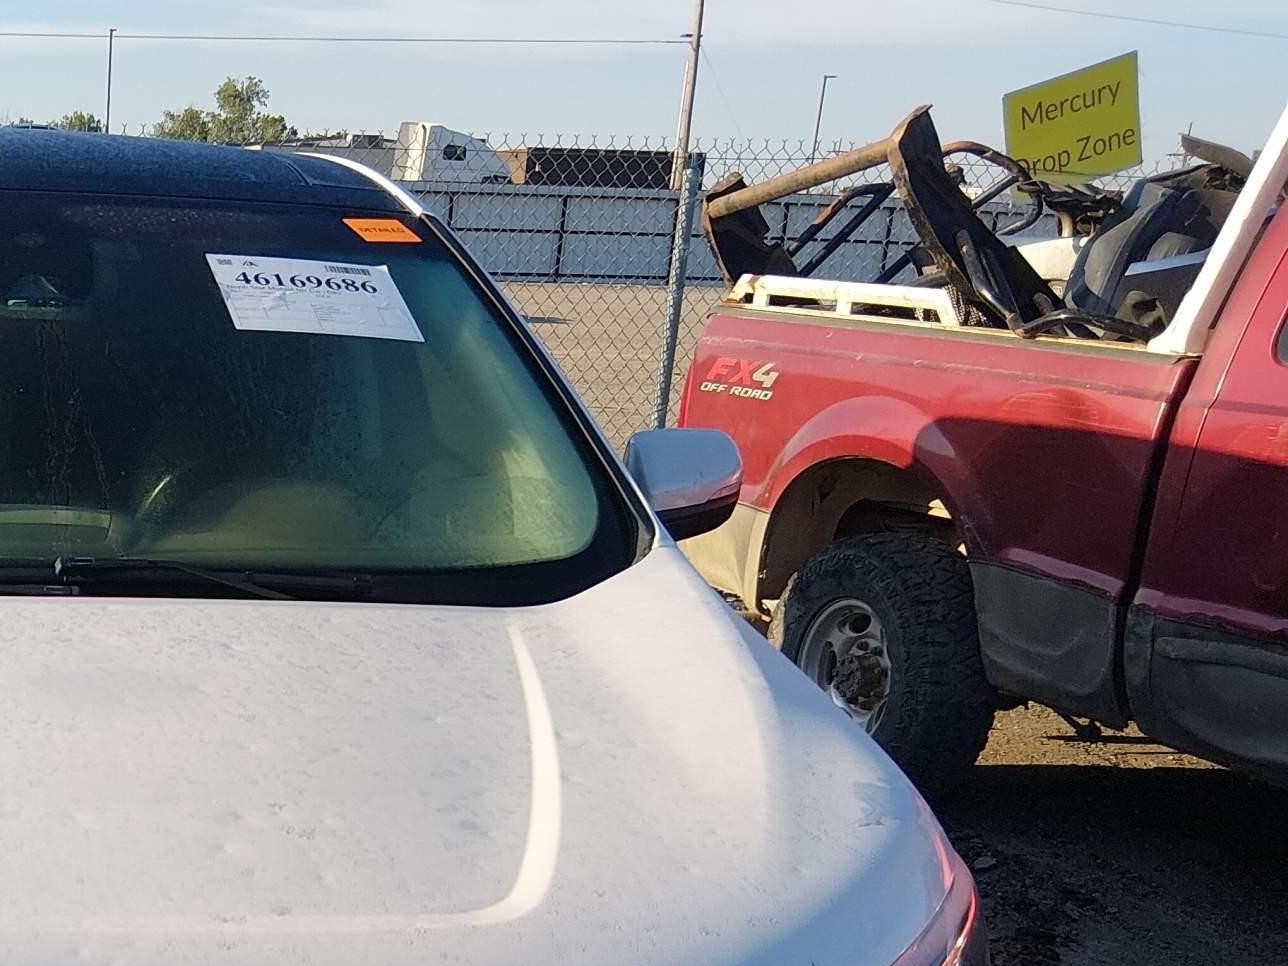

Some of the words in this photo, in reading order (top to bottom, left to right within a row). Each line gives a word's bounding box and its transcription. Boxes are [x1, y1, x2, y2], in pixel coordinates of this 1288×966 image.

[1021, 80, 1121, 130] Mercury
[1076, 127, 1136, 162] Zone
[235, 271, 378, 294] 46169686
[706, 357, 779, 388] FX4
[700, 381, 728, 393] OFF
[729, 386, 773, 400] ROAD
